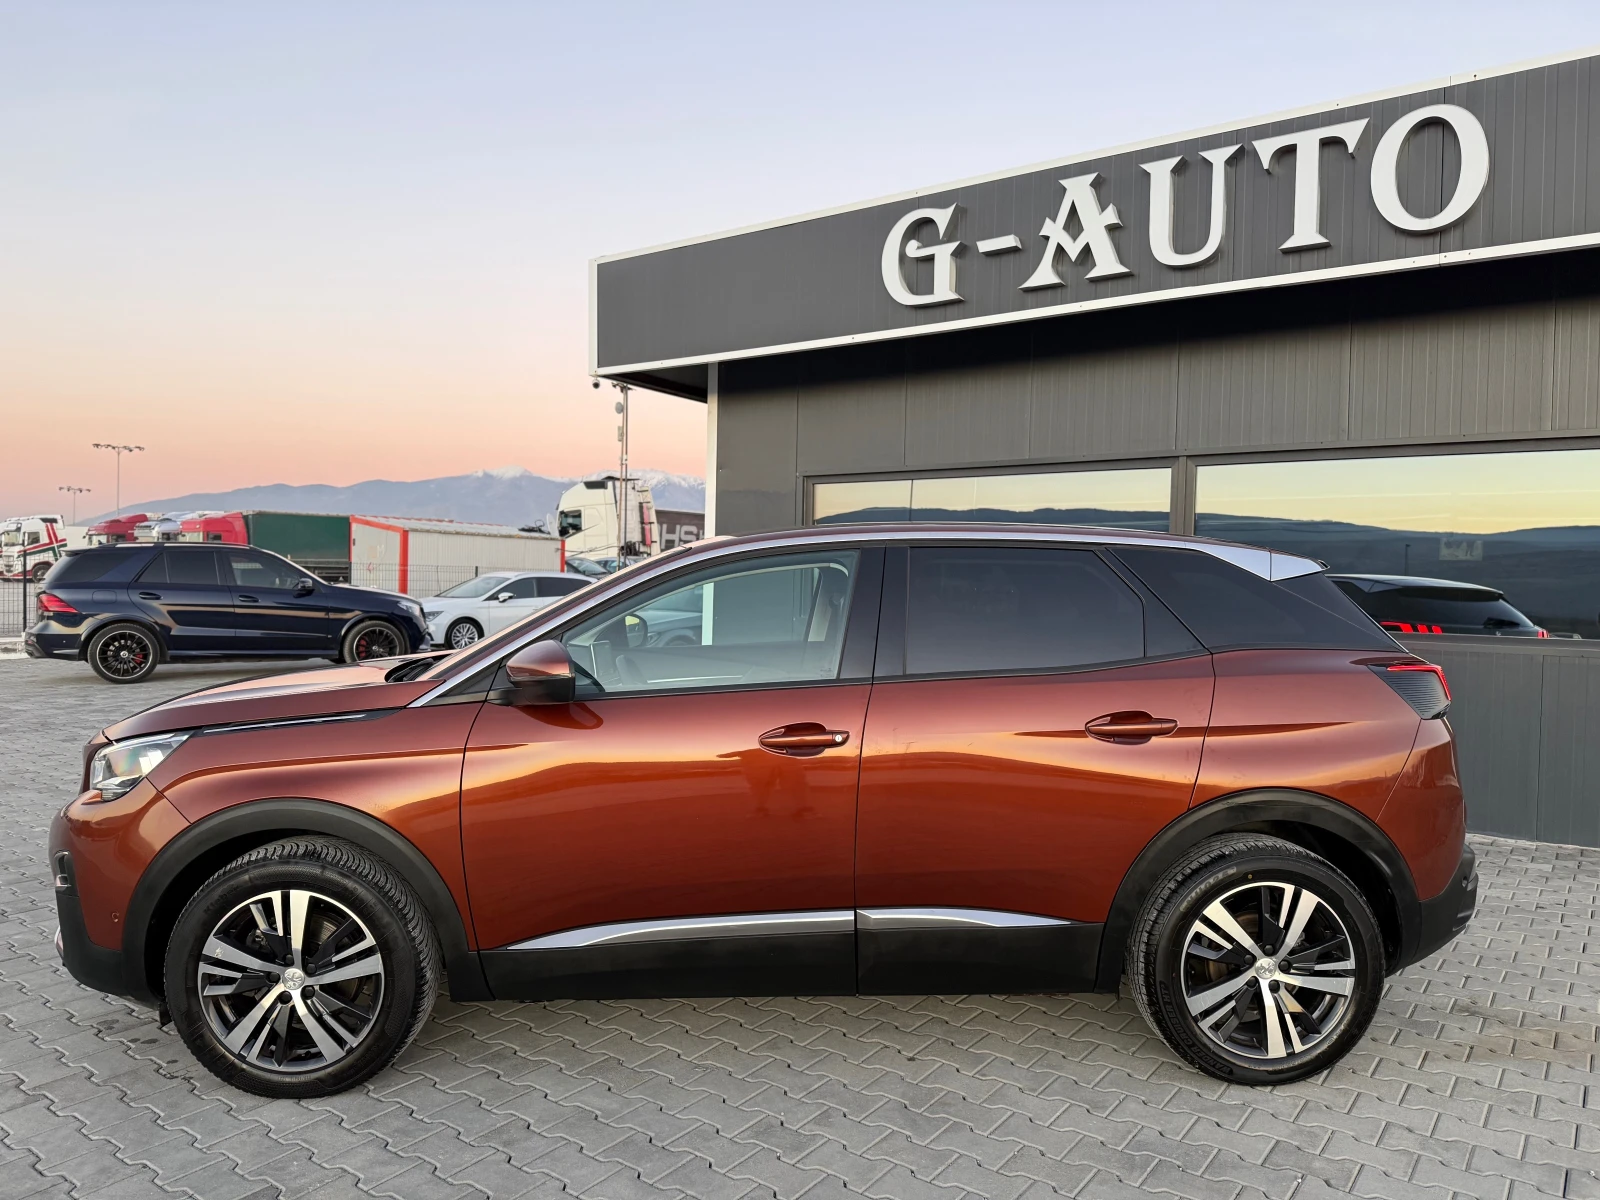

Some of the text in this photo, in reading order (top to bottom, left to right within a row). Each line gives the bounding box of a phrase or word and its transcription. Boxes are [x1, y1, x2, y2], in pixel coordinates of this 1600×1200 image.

[881, 103, 1490, 307] G-AUTO
[1164, 1004, 1193, 1046] CRUISER
[1190, 1044, 1230, 1073] WANDER
